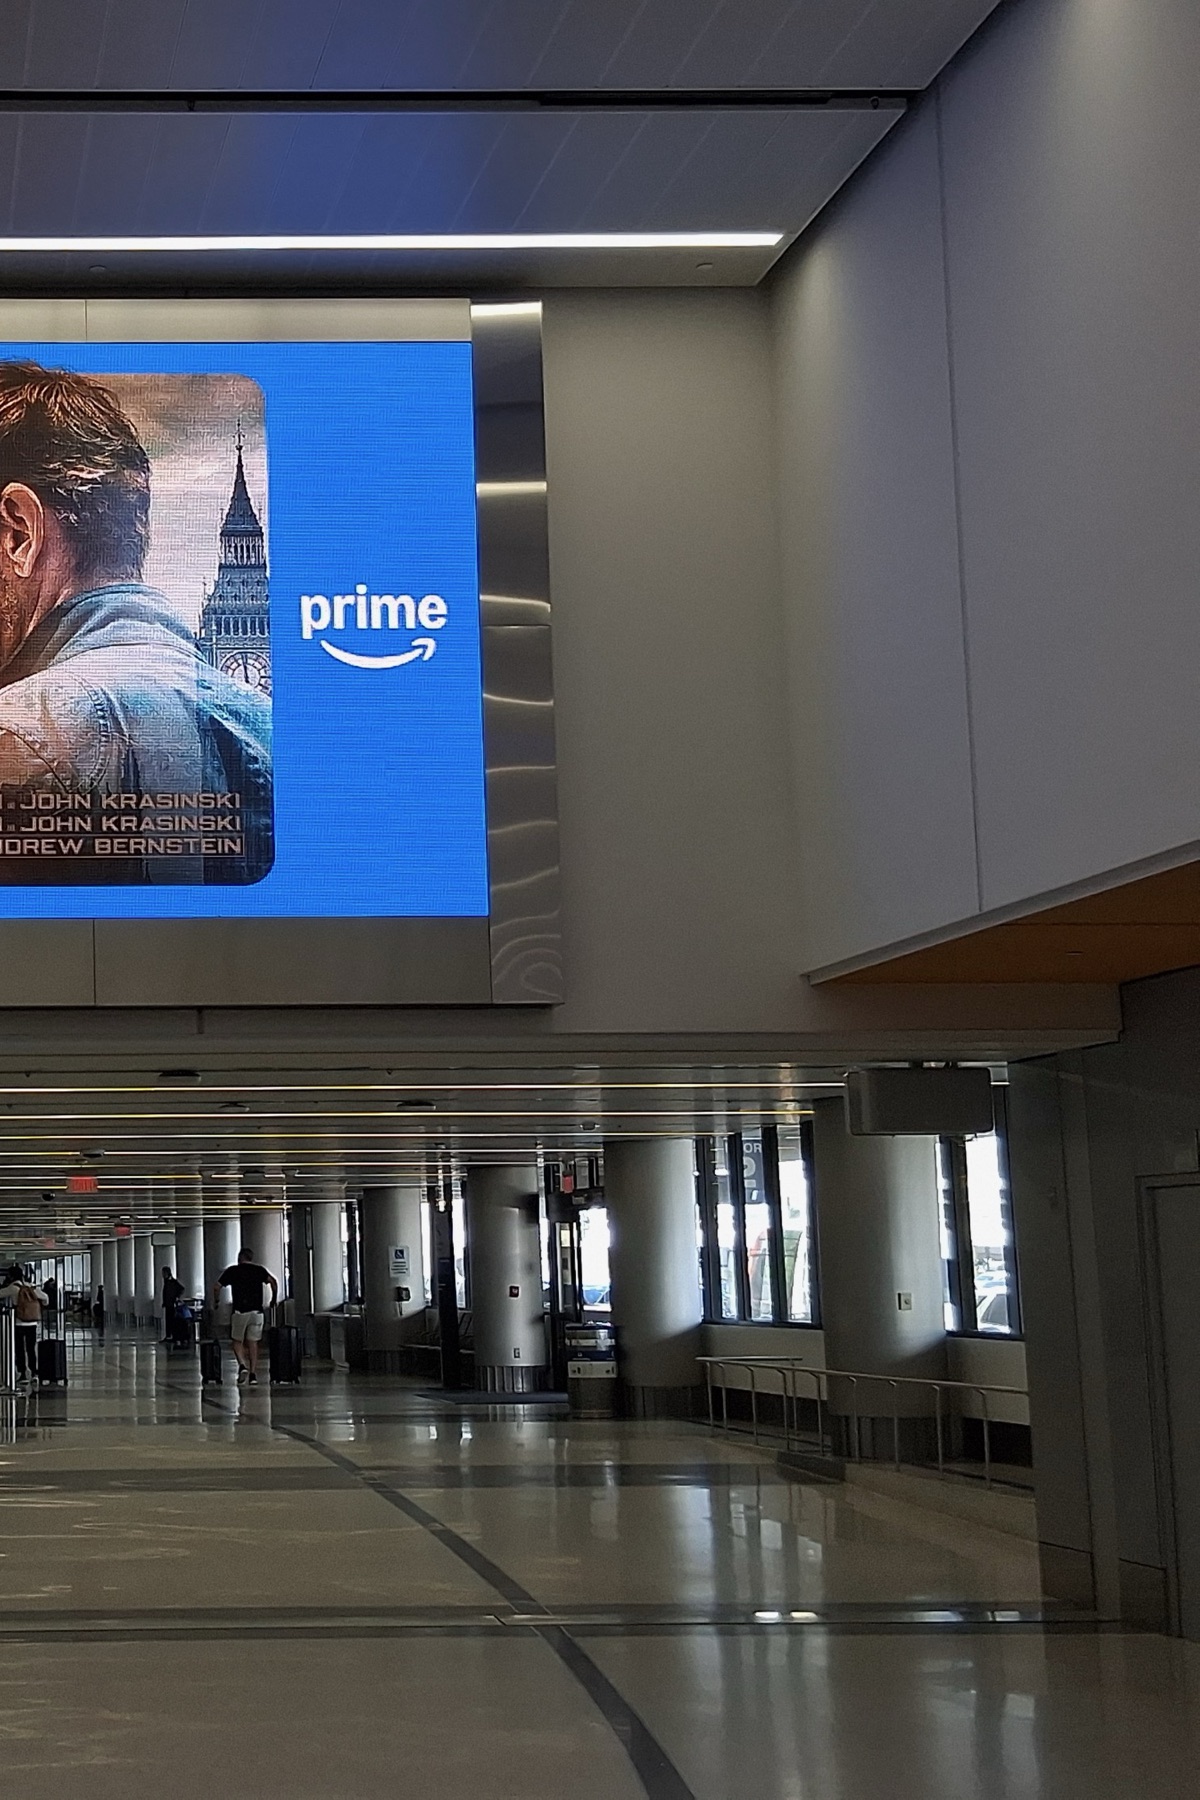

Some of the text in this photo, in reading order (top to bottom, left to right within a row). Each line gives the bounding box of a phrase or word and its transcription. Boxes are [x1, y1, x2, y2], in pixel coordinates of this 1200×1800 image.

[301, 584, 447, 639] prime
[20, 793, 92, 810] JOHN
[101, 793, 241, 810] KRASINSKI
[20, 816, 92, 832] JOHN
[101, 815, 241, 832] KRASINSKI
[94, 838, 242, 855] BERNSTEIN
